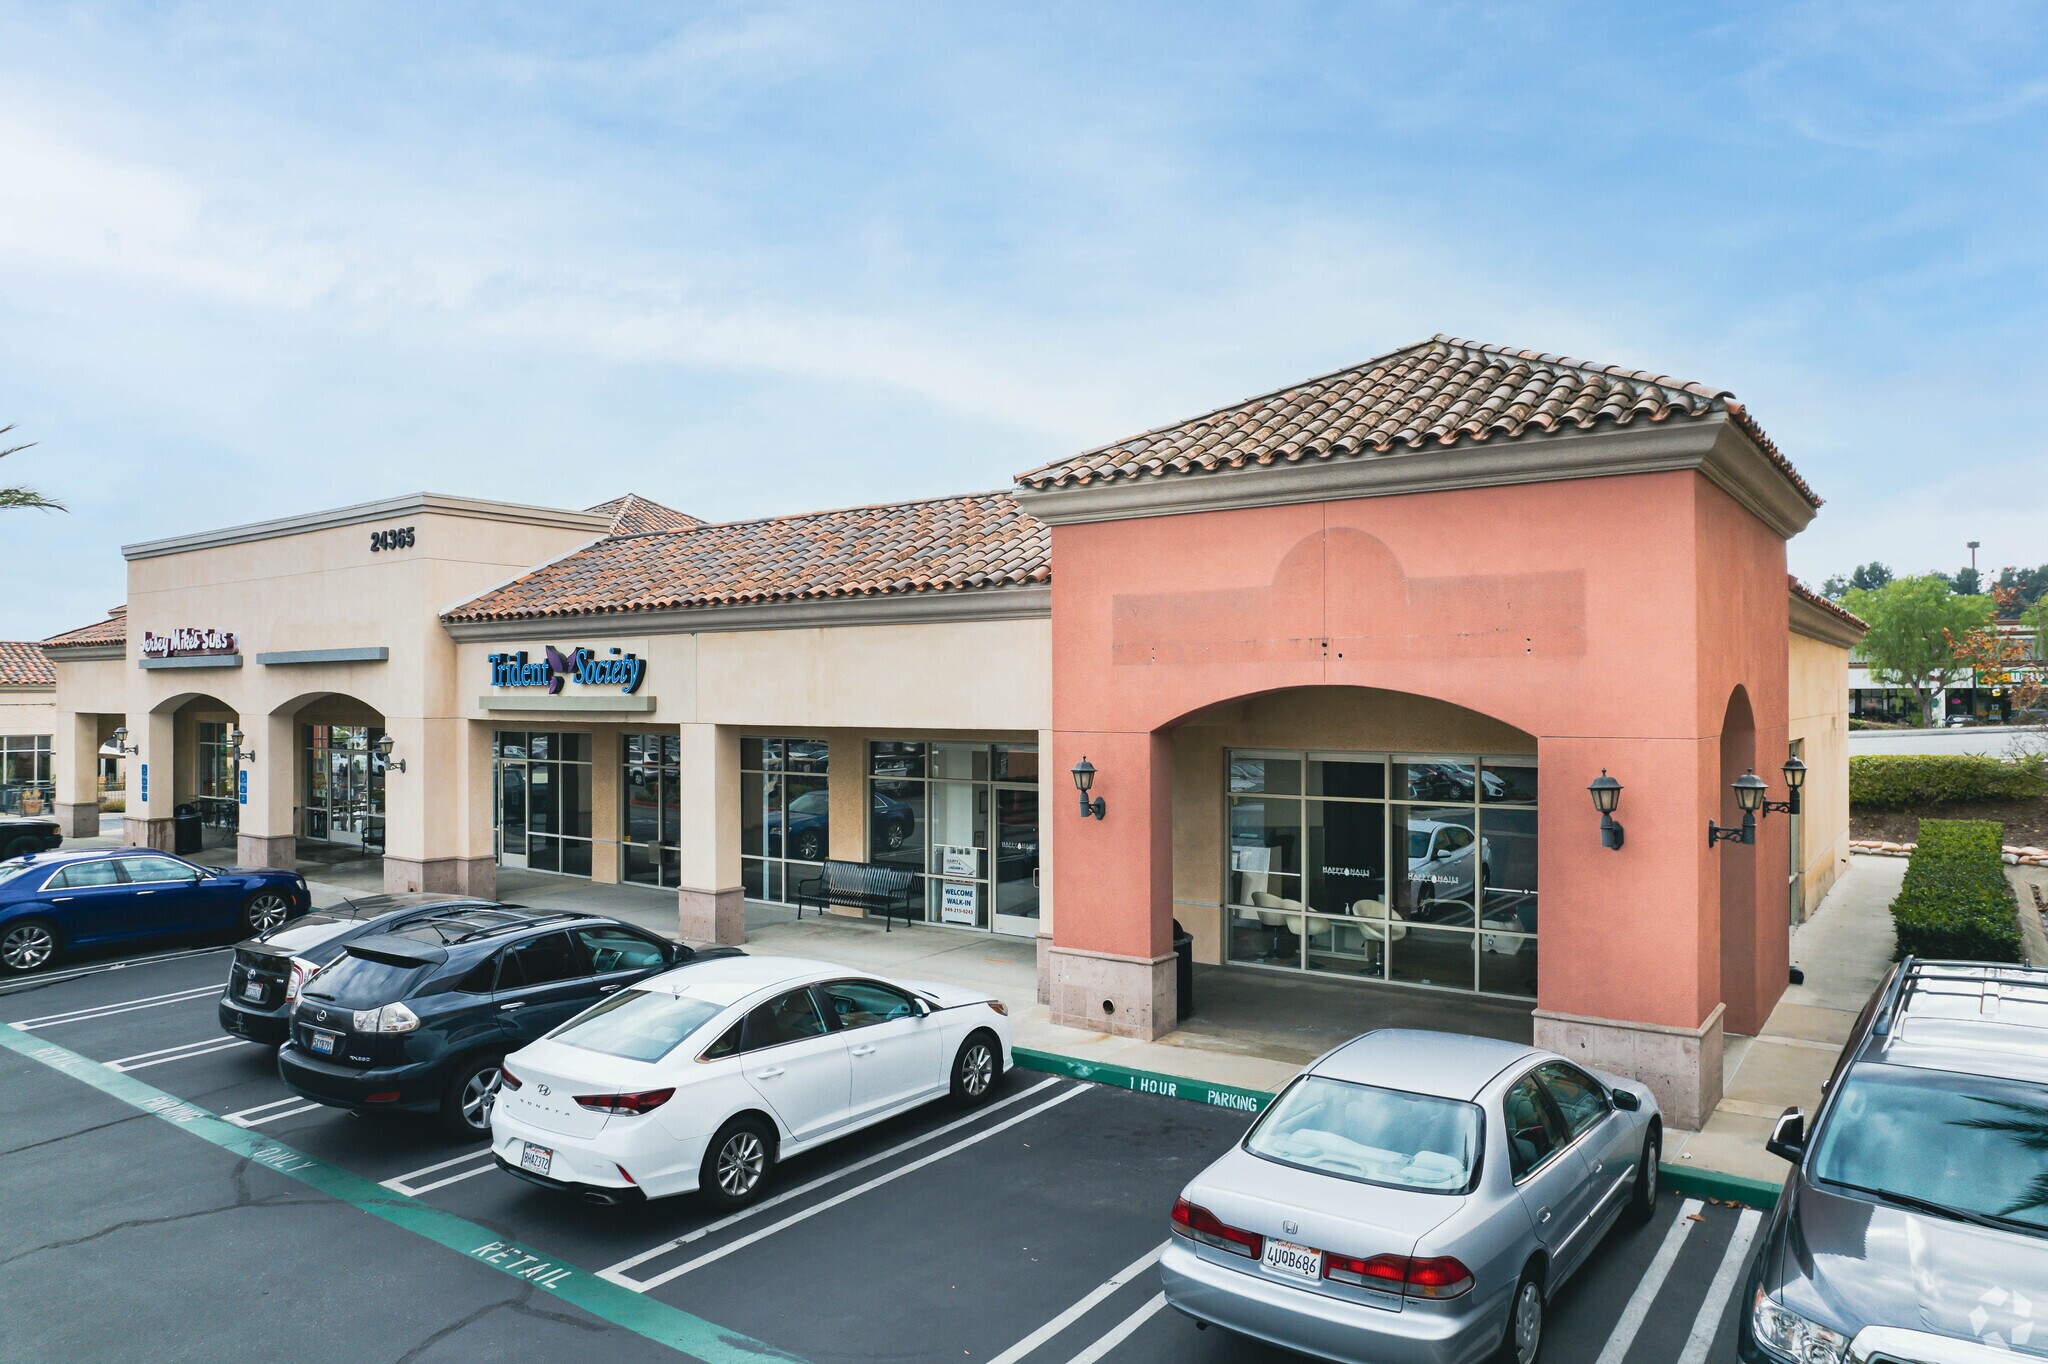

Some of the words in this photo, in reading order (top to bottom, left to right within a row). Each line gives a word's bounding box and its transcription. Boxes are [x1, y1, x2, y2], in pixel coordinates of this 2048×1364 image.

[370, 527, 416, 553] 24365
[140, 631, 169, 658] Jersey
[170, 629, 201, 652] Mike's
[488, 651, 550, 687] Trident
[573, 647, 642, 694] Society
[1322, 866, 1344, 875] HAPPY
[1350, 868, 1370, 877] NAILS
[945, 888, 973, 898] WELCOME
[947, 898, 971, 906] WALK-IN
[1130, 1076, 1135, 1090] 1
[1140, 1077, 1177, 1097] HOUR
[1207, 1090, 1257, 1112] PARKING
[520, 1098, 570, 1117] SONATA
[139, 1096, 205, 1123] PARKING
[253, 1147, 318, 1172] ONLY
[1267, 1246, 1317, 1273] 4UQB686
[1277, 1240, 1309, 1253] California
[470, 1241, 572, 1289] RETAIL
